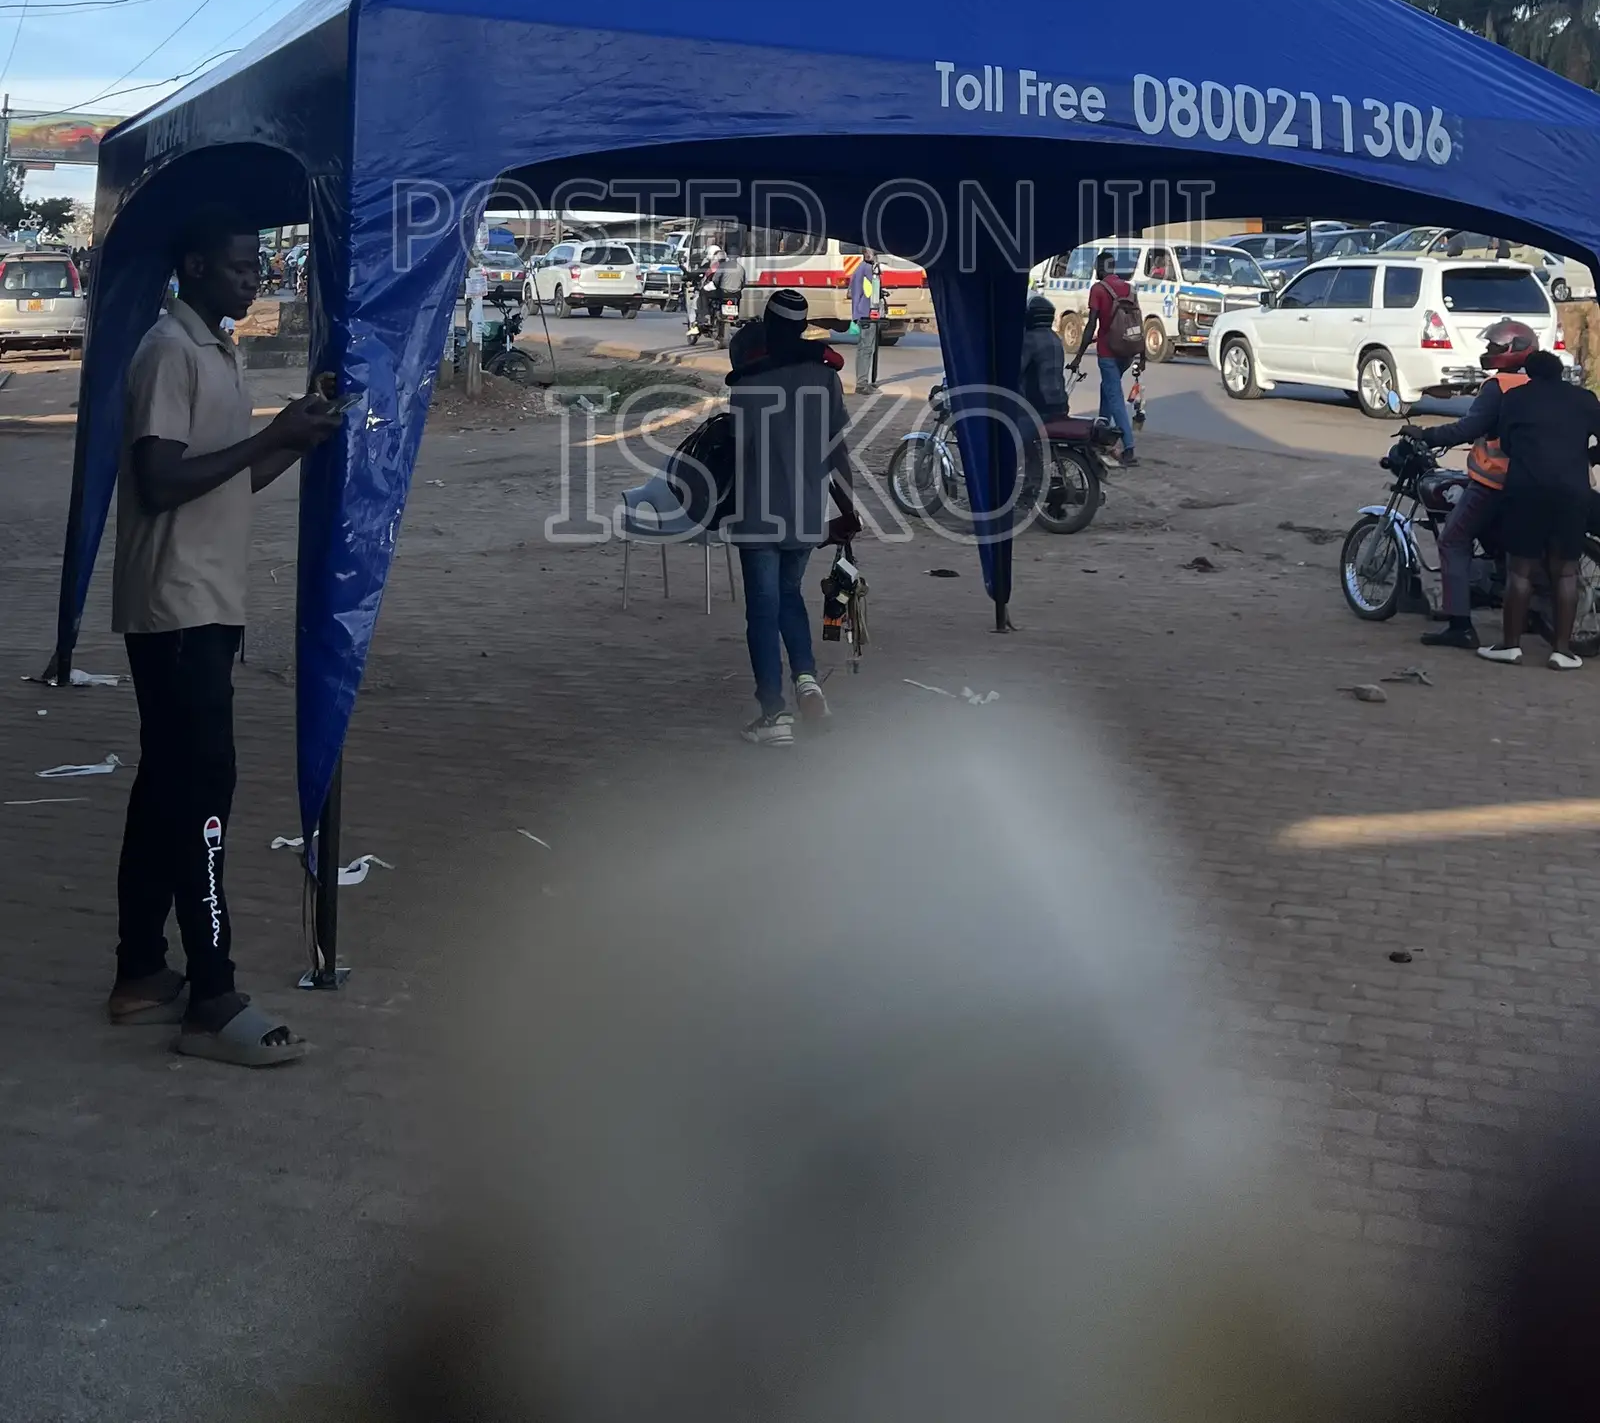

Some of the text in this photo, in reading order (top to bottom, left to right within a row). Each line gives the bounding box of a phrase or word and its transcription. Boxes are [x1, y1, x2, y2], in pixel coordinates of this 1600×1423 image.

[935, 60, 1454, 166] Toll Free 0800211306
[202, 816, 222, 947] Champion
